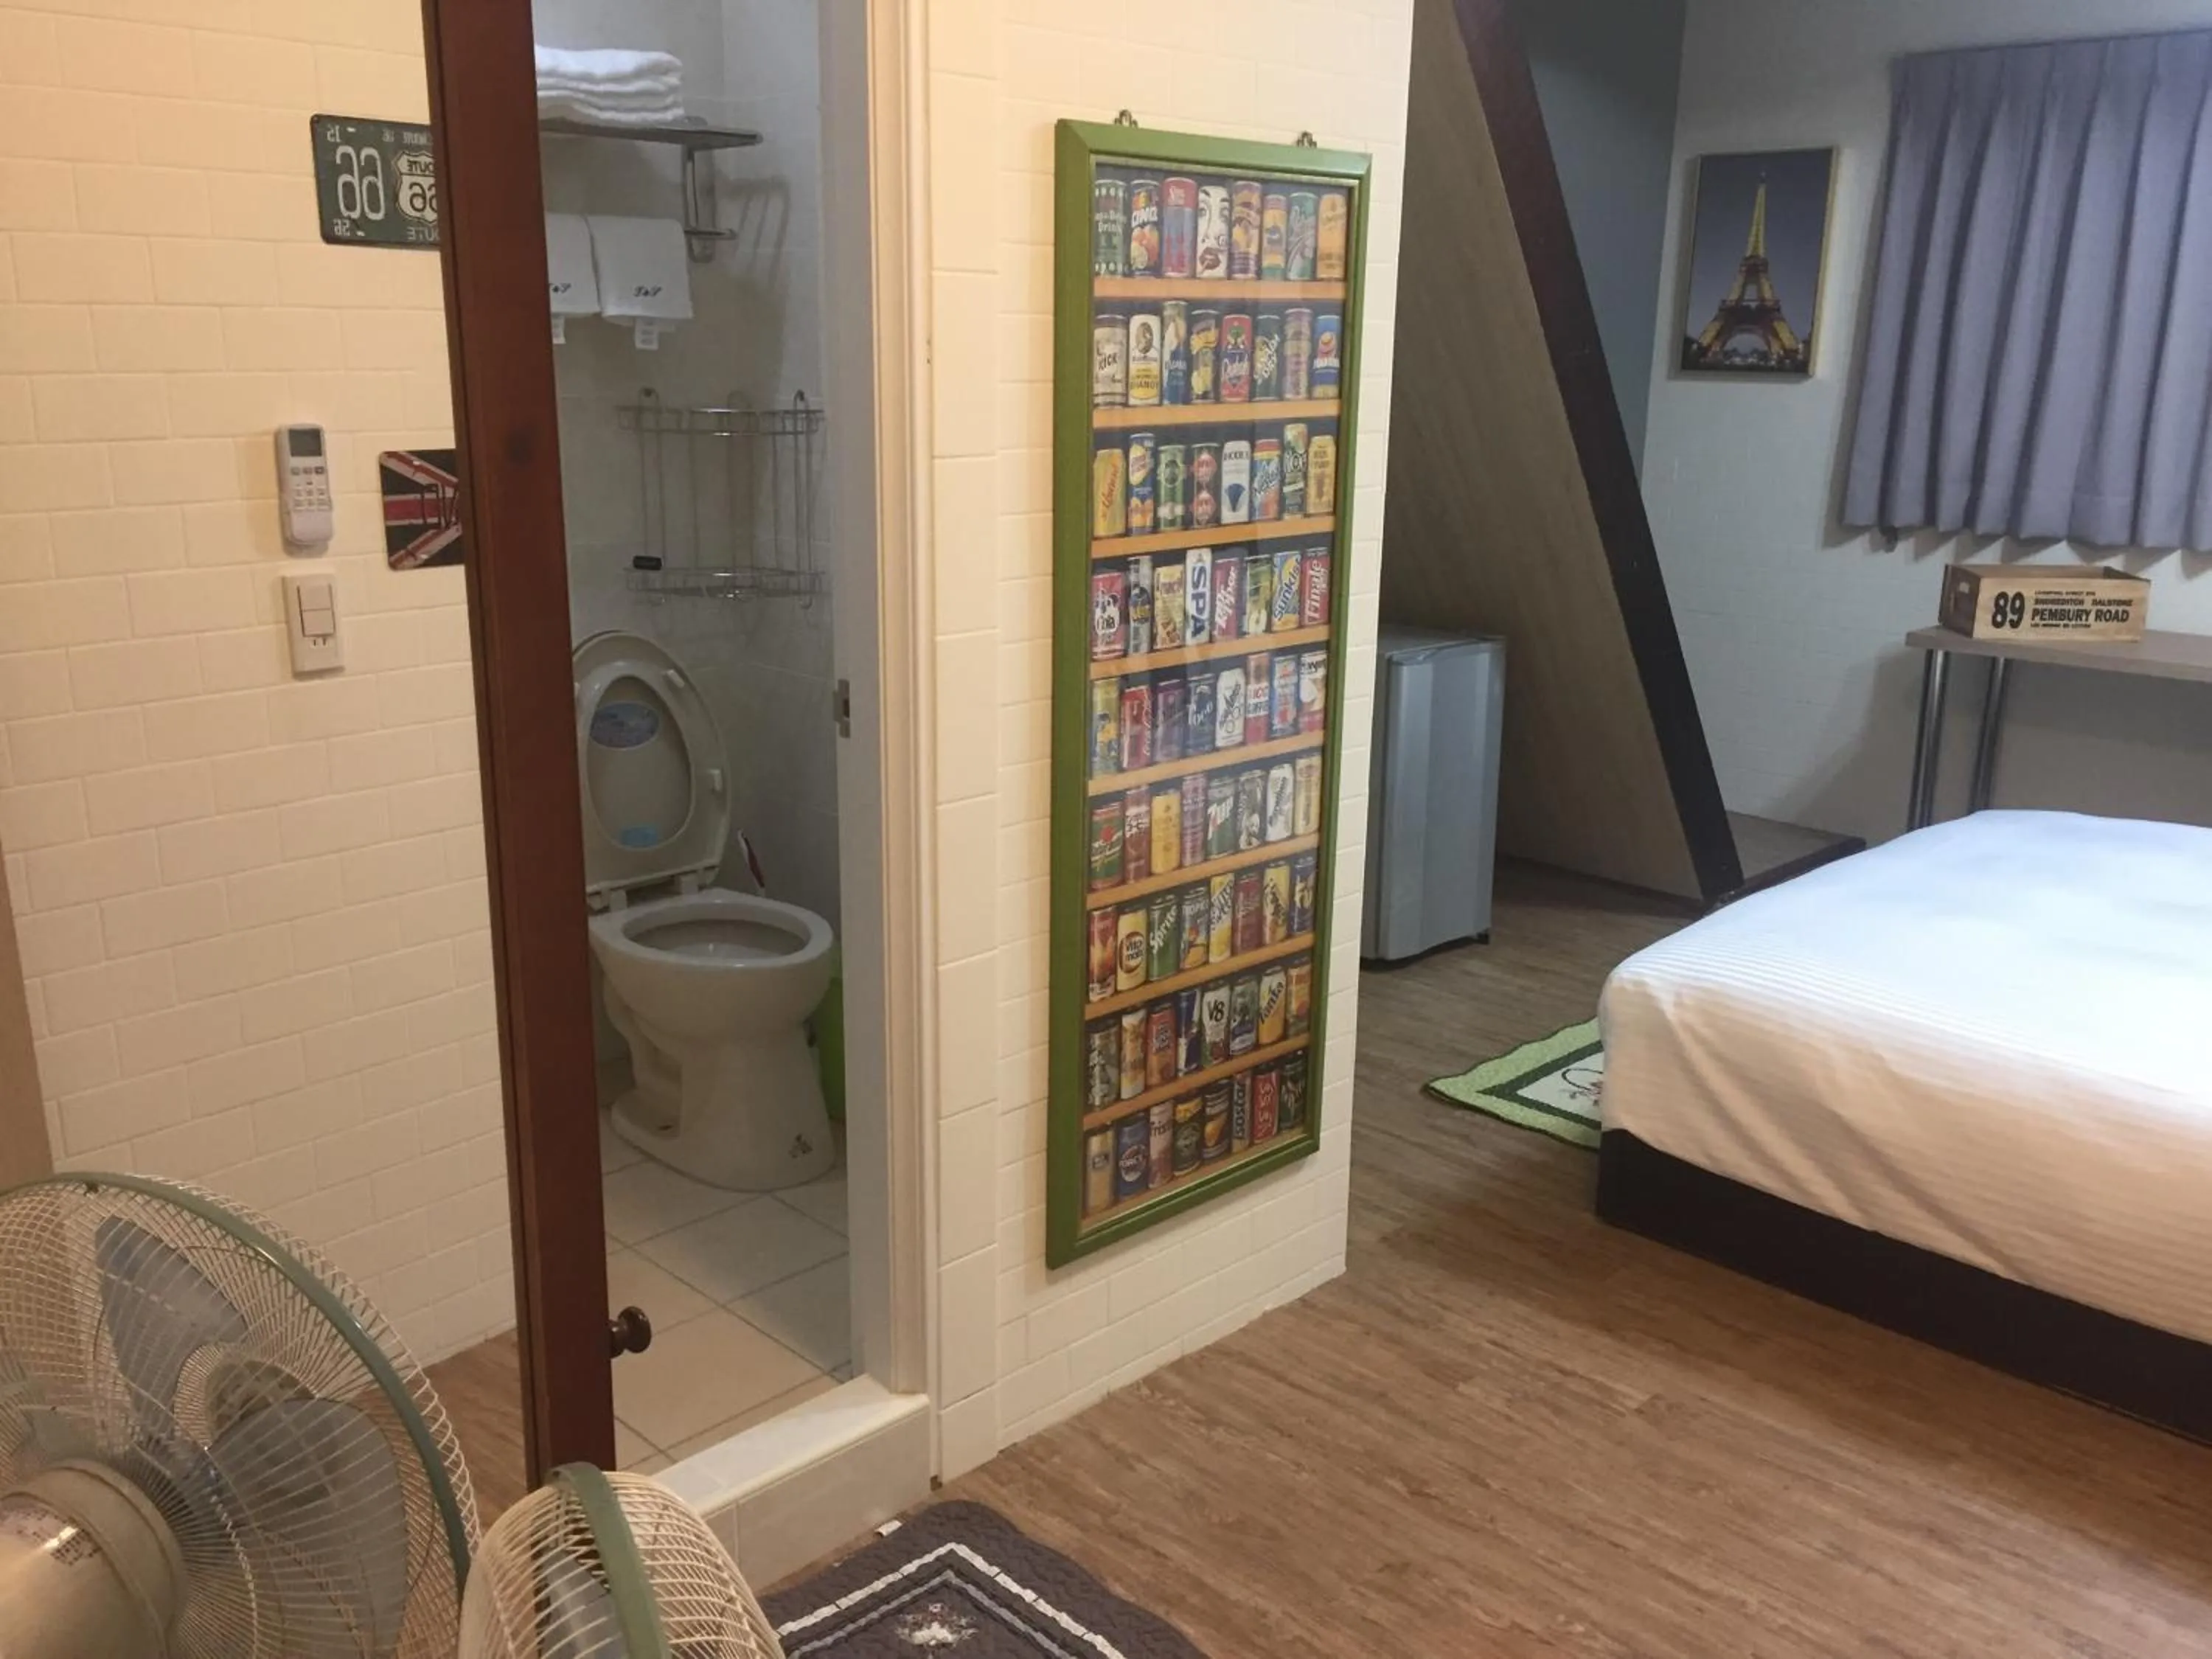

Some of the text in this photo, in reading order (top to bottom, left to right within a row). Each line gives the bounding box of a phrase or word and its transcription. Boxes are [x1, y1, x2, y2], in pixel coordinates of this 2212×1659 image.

[1191, 565, 1208, 639] SPA
[1992, 591, 2025, 628] 89
[2031, 608, 2129, 623] PEMBURY ROAD
[1208, 999, 1225, 1023] V8
